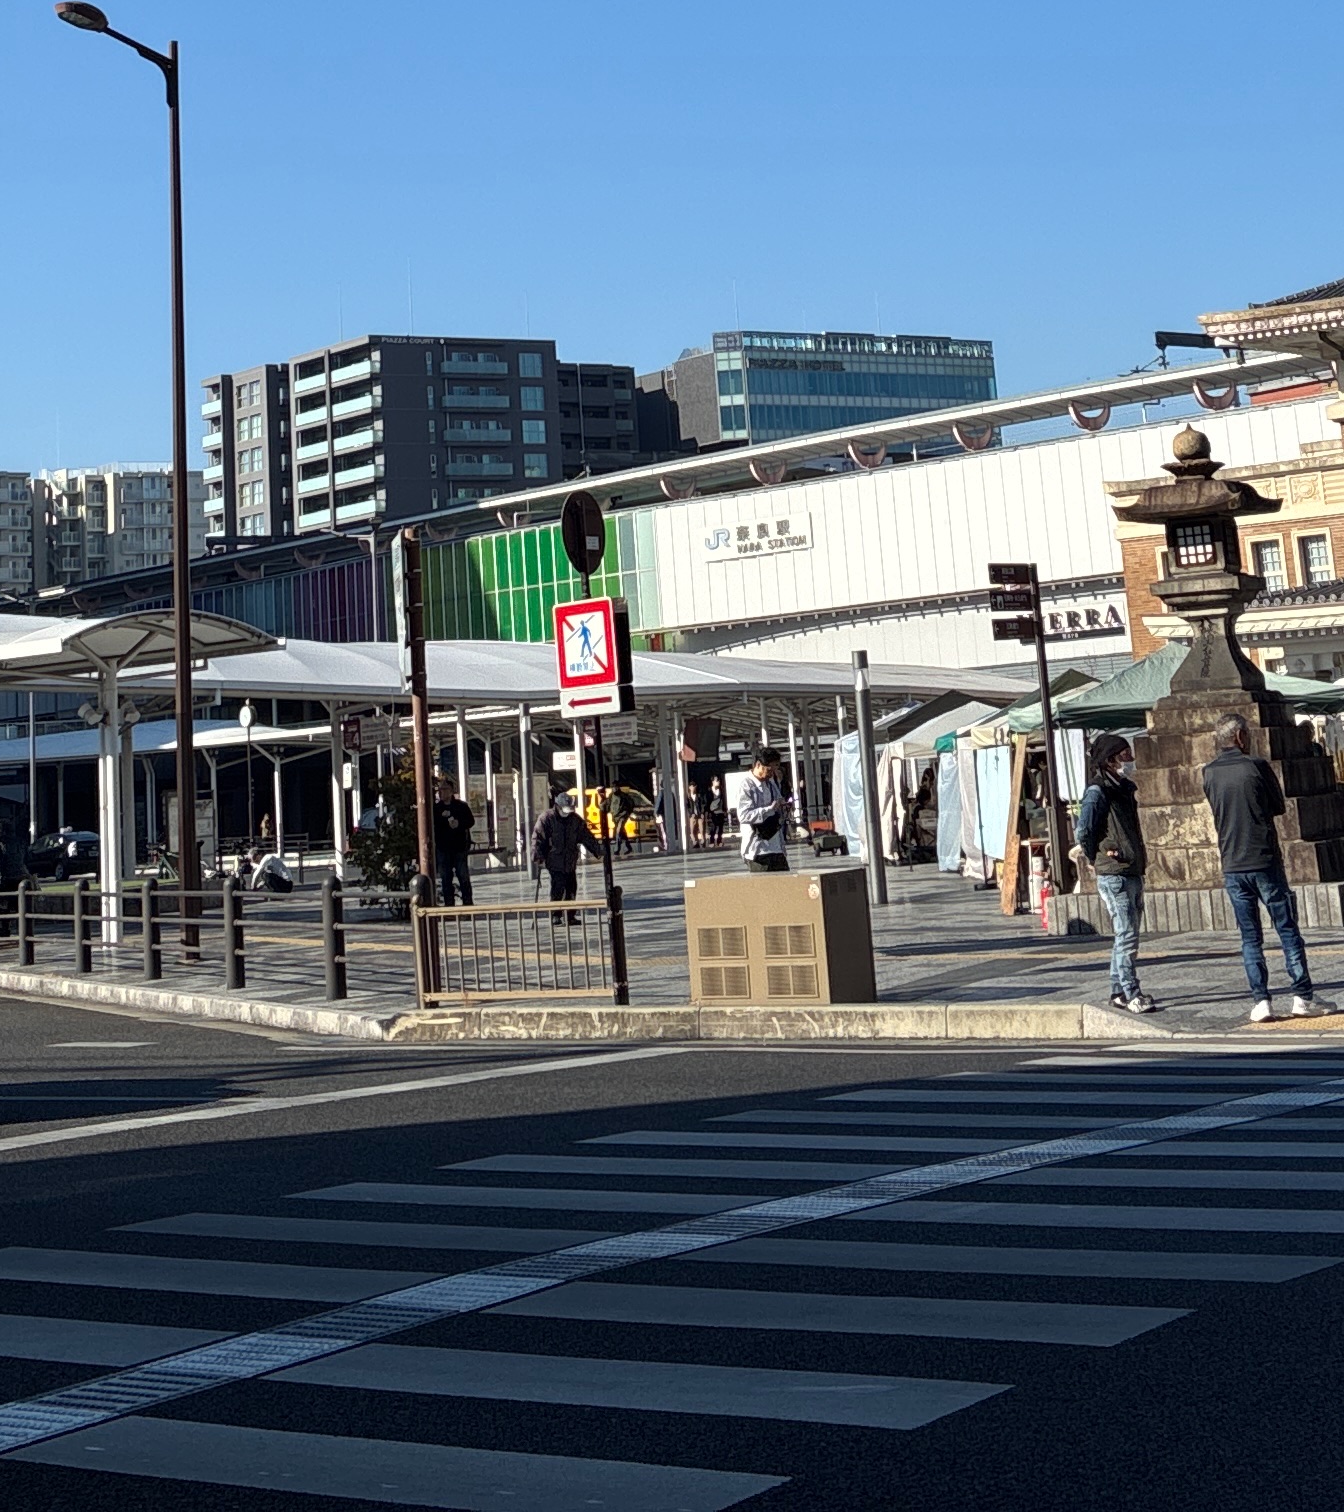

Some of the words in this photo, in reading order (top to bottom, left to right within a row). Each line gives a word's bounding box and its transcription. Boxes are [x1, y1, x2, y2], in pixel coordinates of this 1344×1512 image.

[381, 336, 407, 344] PIAZZA
[704, 528, 731, 551] JR
[736, 519, 790, 542] 奈良駅
[737, 541, 763, 554] NARA
[768, 534, 807, 550] STATION
